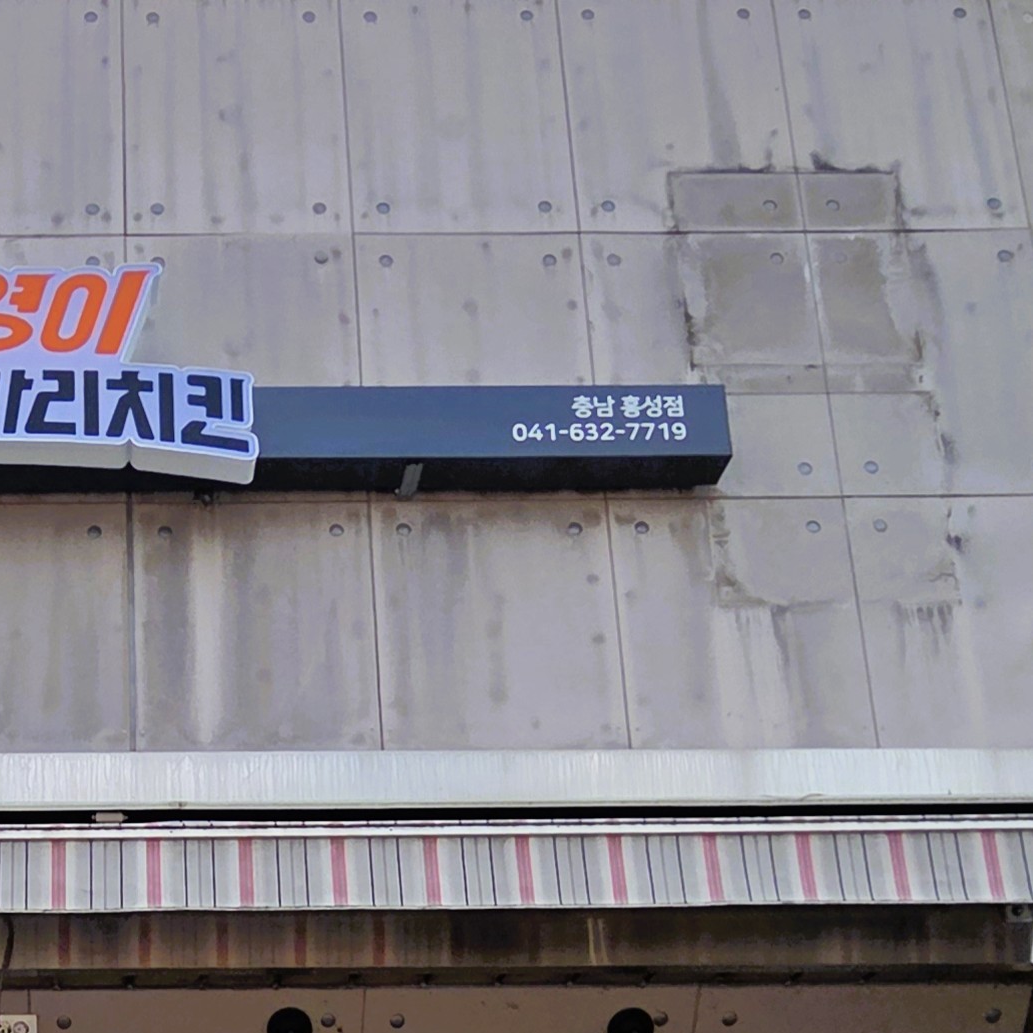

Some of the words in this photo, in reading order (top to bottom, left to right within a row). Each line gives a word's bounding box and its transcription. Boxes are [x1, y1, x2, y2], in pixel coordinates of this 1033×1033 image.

[571, 395, 615, 417] 충남
[620, 395, 685, 418] 홍성점
[512, 422, 687, 441] 041-632-7719
